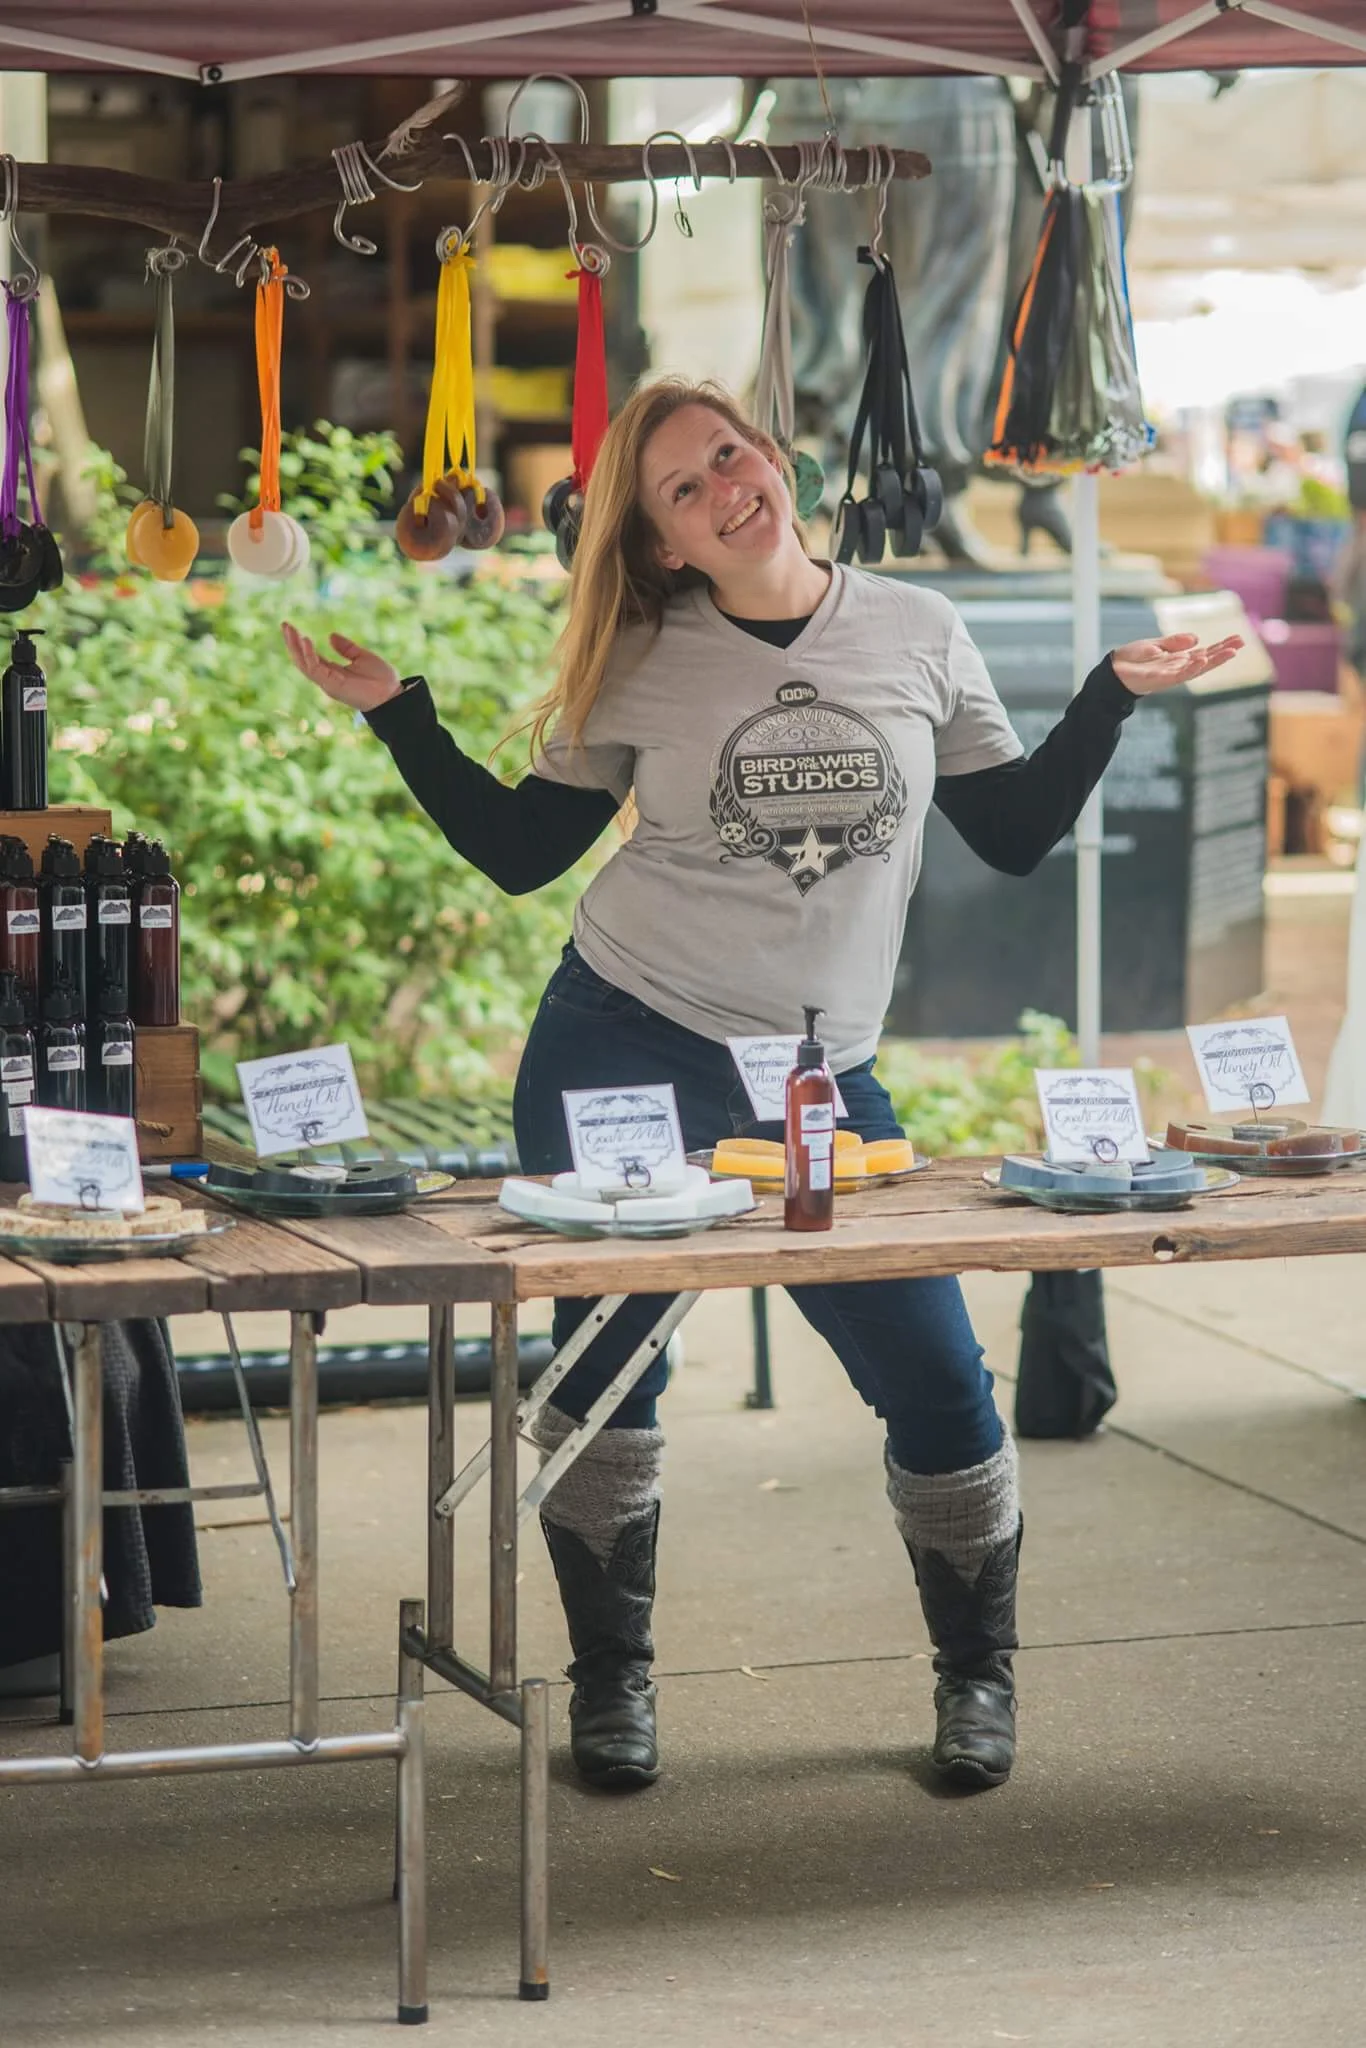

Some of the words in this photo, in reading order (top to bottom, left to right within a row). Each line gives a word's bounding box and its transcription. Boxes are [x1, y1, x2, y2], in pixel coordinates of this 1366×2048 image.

[778, 687, 816, 701] 100%
[754, 708, 852, 736] KNOXVILLE
[740, 756, 796, 775] BIRD
[796, 755, 815, 763] ON
[799, 762, 820, 771] THE
[819, 752, 878, 769] WIRE
[743, 768, 880, 795] STUDIOS
[264, 1094, 313, 1116] Honey
[315, 1084, 345, 1105] Oil
